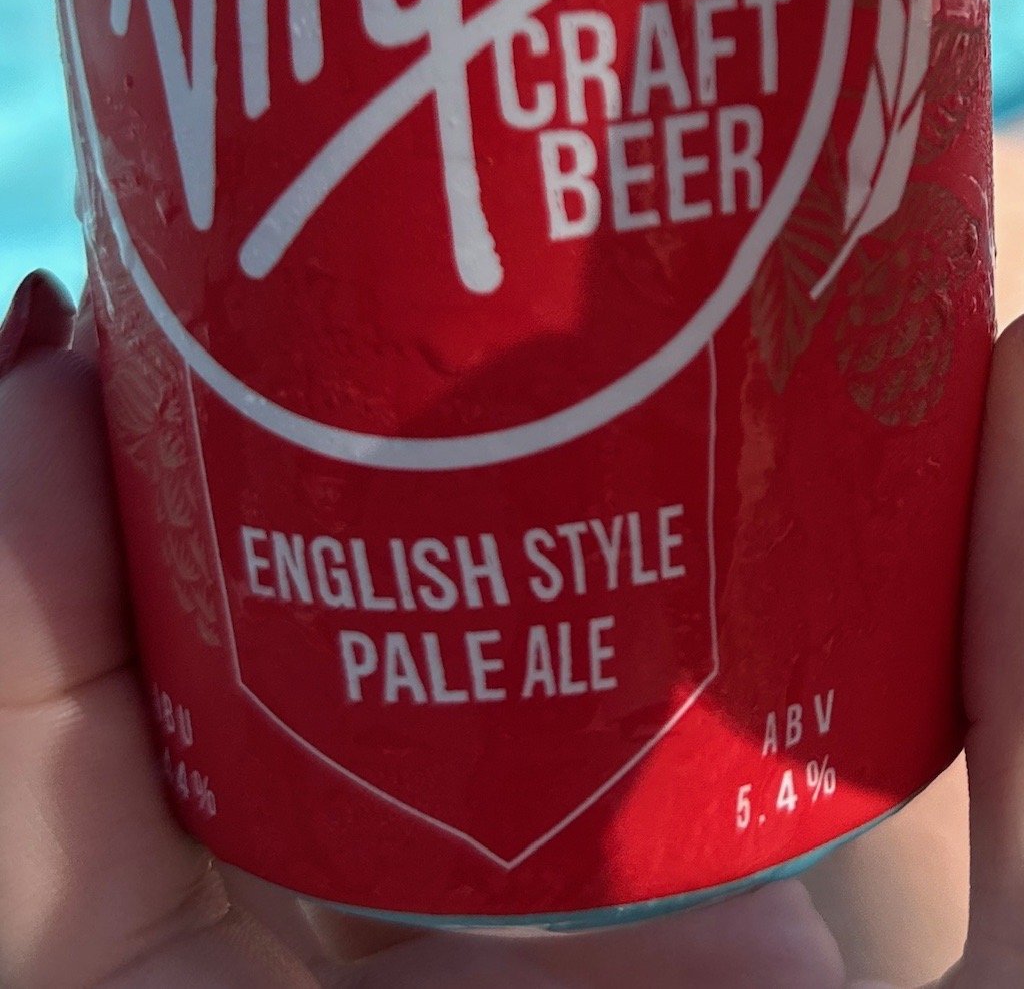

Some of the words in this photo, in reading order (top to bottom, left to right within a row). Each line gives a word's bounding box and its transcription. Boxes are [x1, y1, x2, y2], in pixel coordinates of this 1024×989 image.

[539, 104, 767, 243] BEER
[239, 525, 511, 611] ENGLISH
[523, 504, 687, 603] STYLE
[339, 628, 507, 706] PALE
[521, 616, 619, 700] ALE
[734, 757, 838, 831] 5.4%
